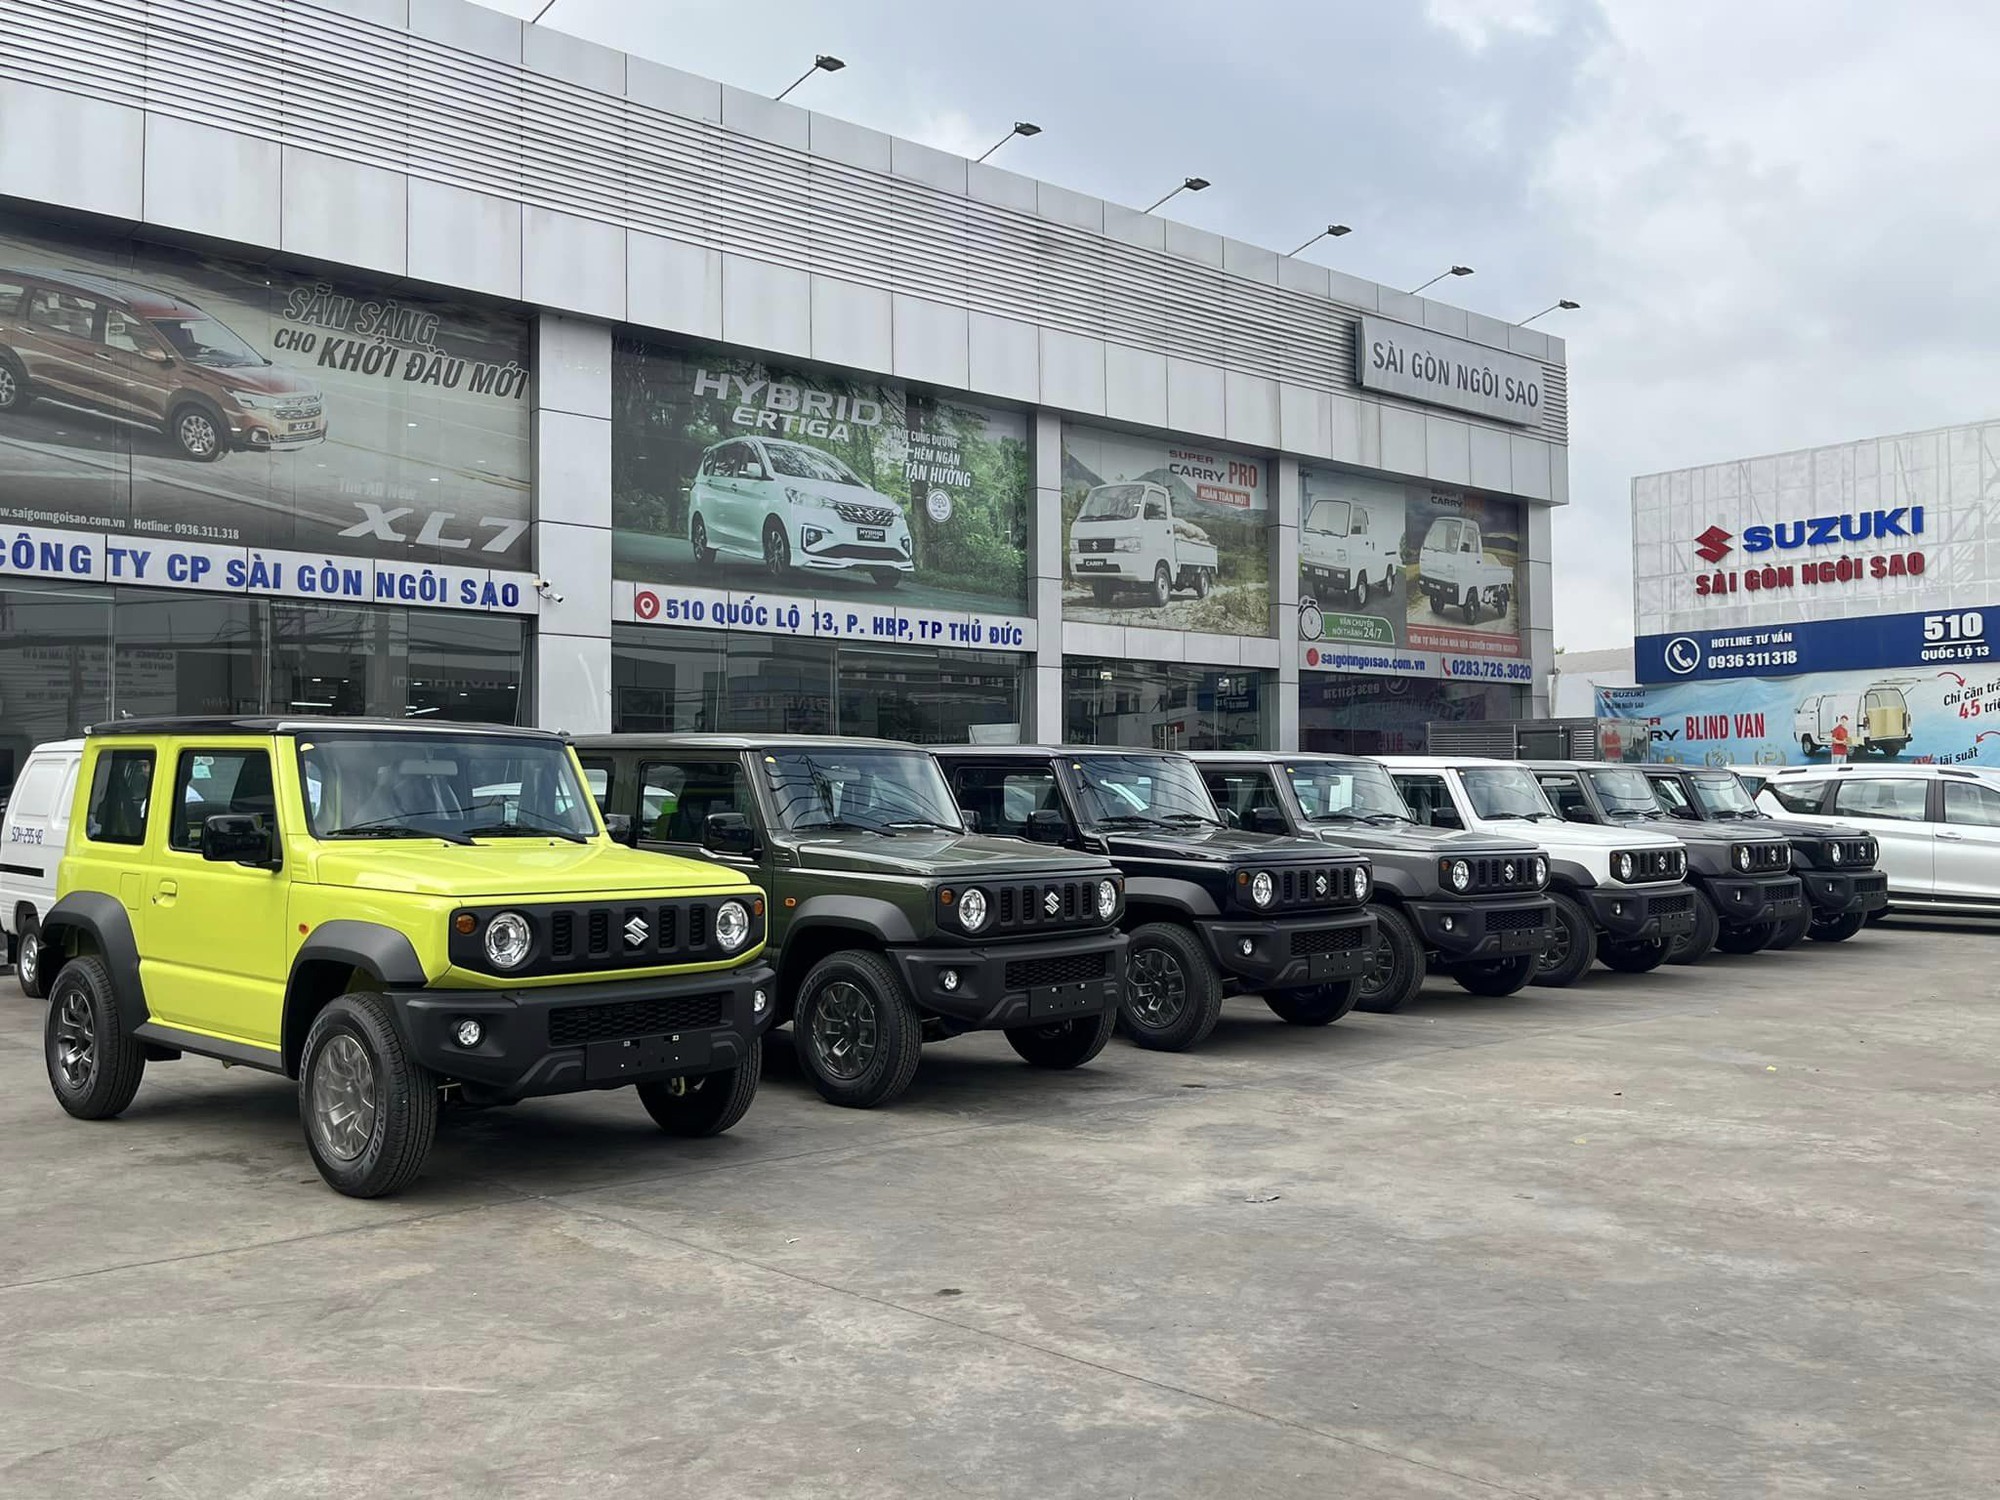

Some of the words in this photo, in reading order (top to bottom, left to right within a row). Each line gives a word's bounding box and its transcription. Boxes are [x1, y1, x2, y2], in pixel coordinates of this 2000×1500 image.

[282, 283, 354, 330] SẴN
[355, 299, 440, 346] SÀNG
[273, 328, 317, 354] CHO
[316, 336, 400, 378] KHỞI
[403, 345, 466, 389] ĐẦU
[467, 360, 530, 400] MỚI
[1372, 340, 1404, 374] SÀI
[1411, 350, 1450, 386] GÒN
[1457, 364, 1499, 399] NGÔI
[1504, 376, 1539, 408] SAO
[693, 369, 883, 427] HYBRID
[294, 421, 314, 431] XL7
[731, 405, 850, 442] ERTIGA
[905, 461, 928, 482] TẬN
[1169, 449, 1214, 465] SUPER
[1169, 463, 1225, 483] CARRY
[1228, 460, 1258, 489] PRO
[1430, 495, 1464, 508] CARRY
[134, 518, 172, 534] Hotline:
[175, 522, 240, 540] 0936.311.318
[337, 501, 531, 553] XL7
[1742, 506, 1925, 551] SUZUKI
[0, 532, 92, 574] ÔNG
[107, 547, 152, 579] TY
[167, 553, 211, 583] CP
[226, 554, 282, 589] SÀI
[296, 559, 363, 596] GÒN
[376, 569, 448, 603] NGÔI
[460, 579, 520, 608] SAO
[1695, 569, 1738, 596] SÀI
[1744, 562, 1795, 592] GÒN
[1870, 551, 1925, 579] SAO
[666, 599, 704, 622] 510
[712, 595, 768, 627] QUỐC
[776, 605, 801, 633] LỘ
[811, 611, 839, 636] 13,
[847, 615, 865, 635] P.
[872, 616, 913, 641] HBP,
[919, 620, 942, 639] TP
[949, 618, 982, 643] THỦ
[989, 620, 1023, 647] ĐỨC
[1363, 627, 1383, 640] 24/7
[1923, 611, 1984, 641] 510
[1711, 635, 1753, 649] HOTLINE
[1755, 634, 1769, 645] TƯ
[1771, 629, 1793, 644] VẤN
[1921, 644, 1955, 662] QUỐC
[1957, 646, 1973, 661] LỘ
[1975, 645, 1990, 657] 13
[1320, 653, 1426, 671] saigonngoisao.com.vn
[1452, 659, 1532, 681] 0283.726.3020
[1707, 653, 1745, 669] 0936
[1746, 652, 1770, 667] 311
[1771, 650, 1798, 665] 318
[1612, 690, 1646, 698] SUZUKI
[1959, 698, 1981, 719] 45
[1685, 714, 1729, 741] BLIND
[1734, 712, 1766, 739] VAN
